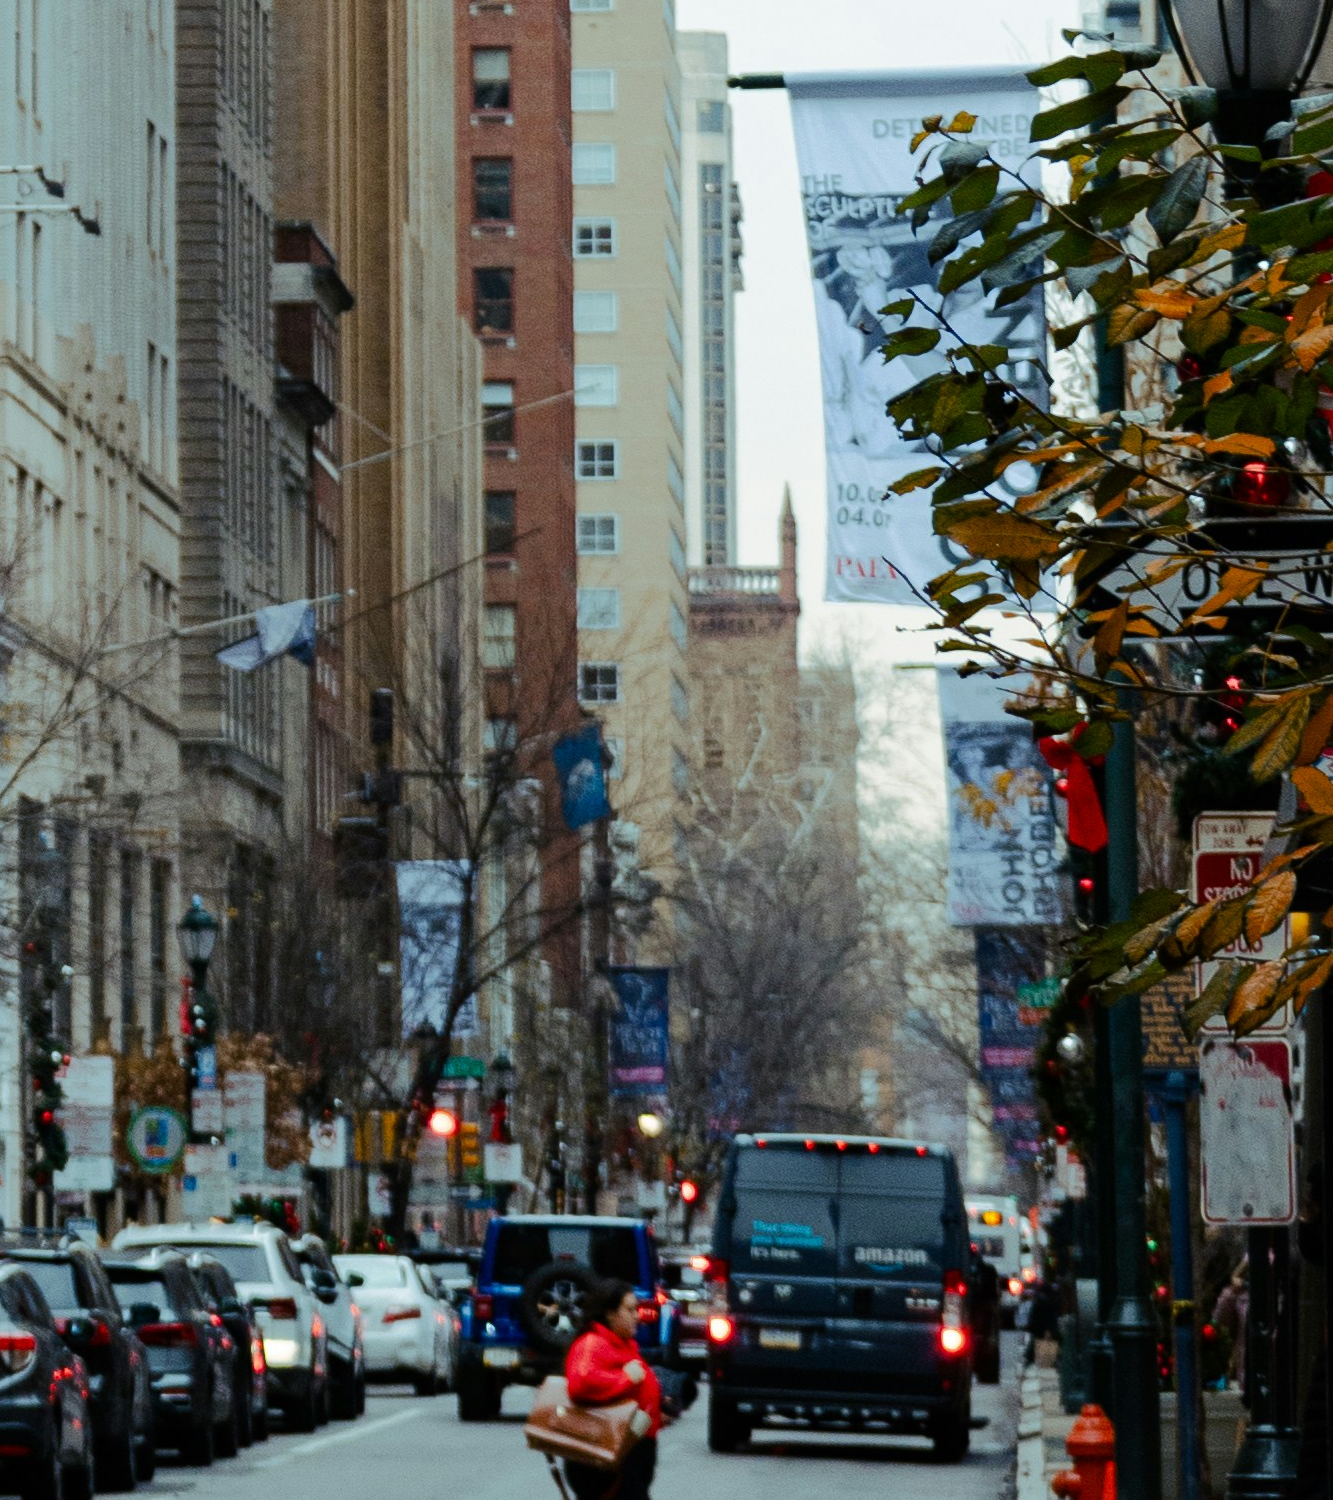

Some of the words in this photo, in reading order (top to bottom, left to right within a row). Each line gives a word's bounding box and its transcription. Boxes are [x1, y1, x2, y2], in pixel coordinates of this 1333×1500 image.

[803, 174, 842, 192] THE
[1230, 857, 1254, 880] NO
[854, 1246, 929, 1265] amazon
